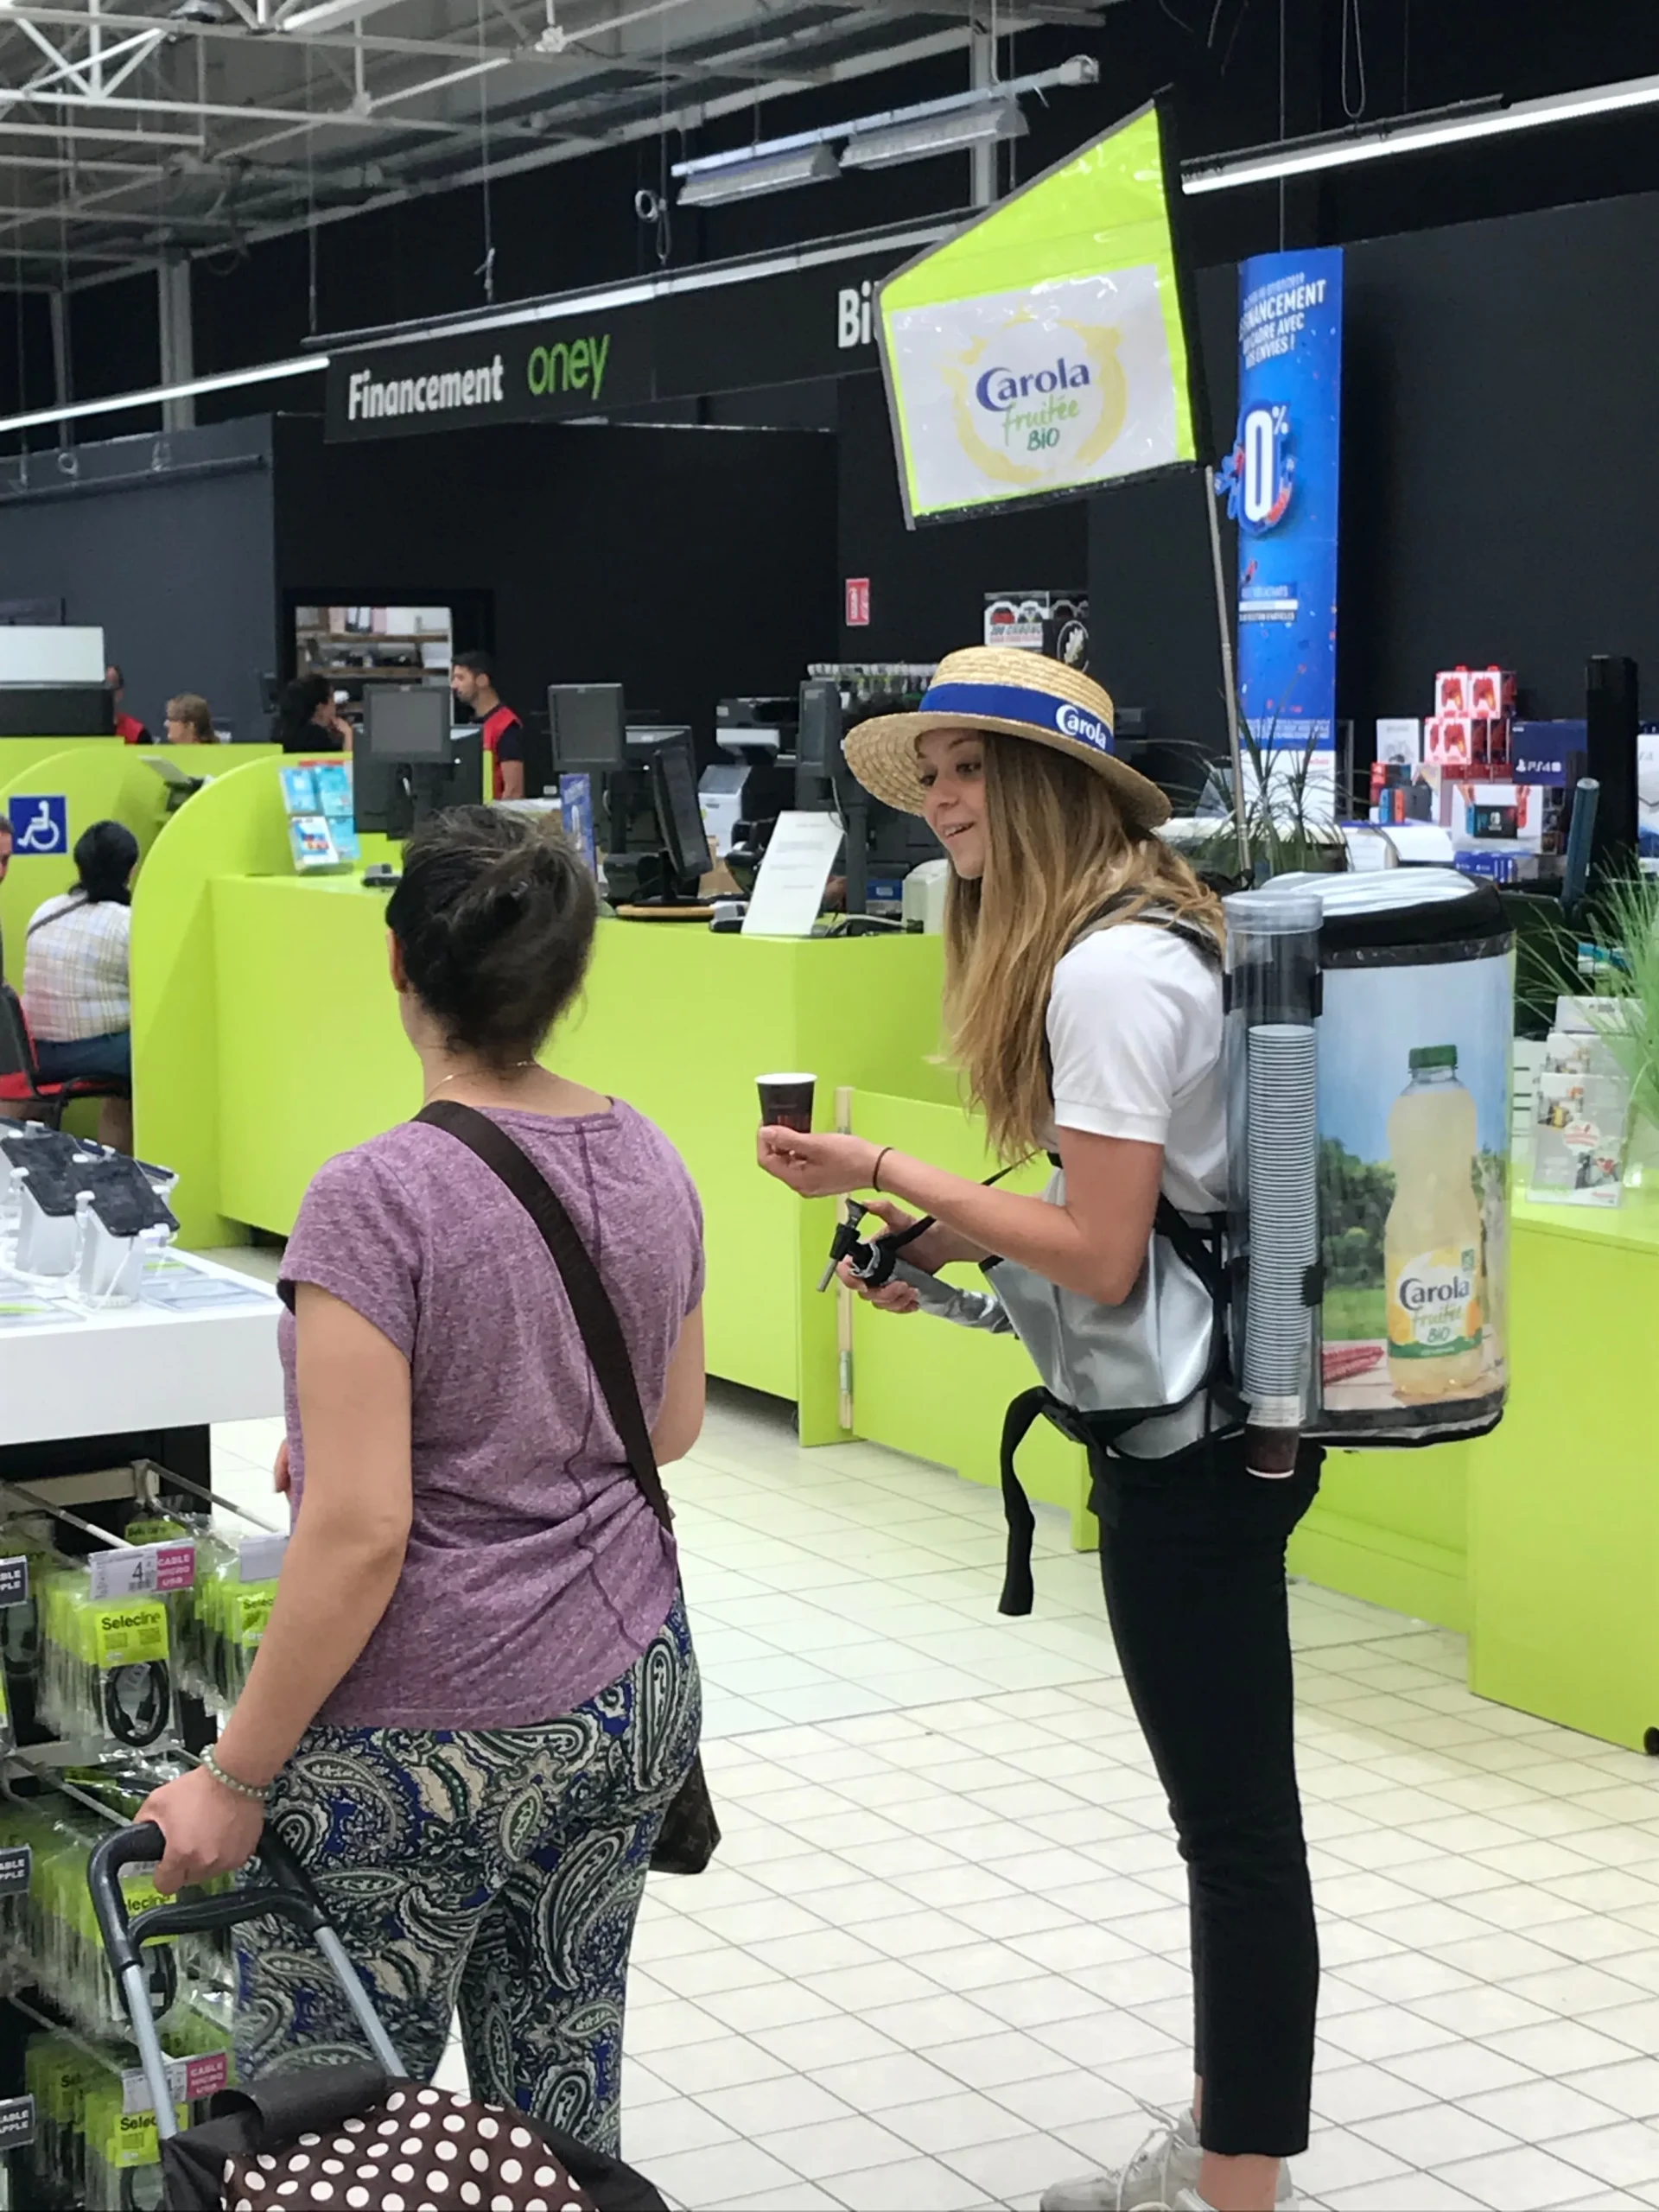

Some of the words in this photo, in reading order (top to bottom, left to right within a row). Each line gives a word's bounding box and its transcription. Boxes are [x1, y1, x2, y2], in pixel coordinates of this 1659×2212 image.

[838, 280, 878, 347] Bi
[348, 353, 504, 421] Financement
[528, 334, 610, 400] oney
[976, 357, 1090, 412] Carola
[1056, 704, 1107, 750] Carola
[1400, 1275, 1470, 1311] Carola
[0, 1570, 21, 1581] BLE
[0, 1580, 21, 1591] PLE
